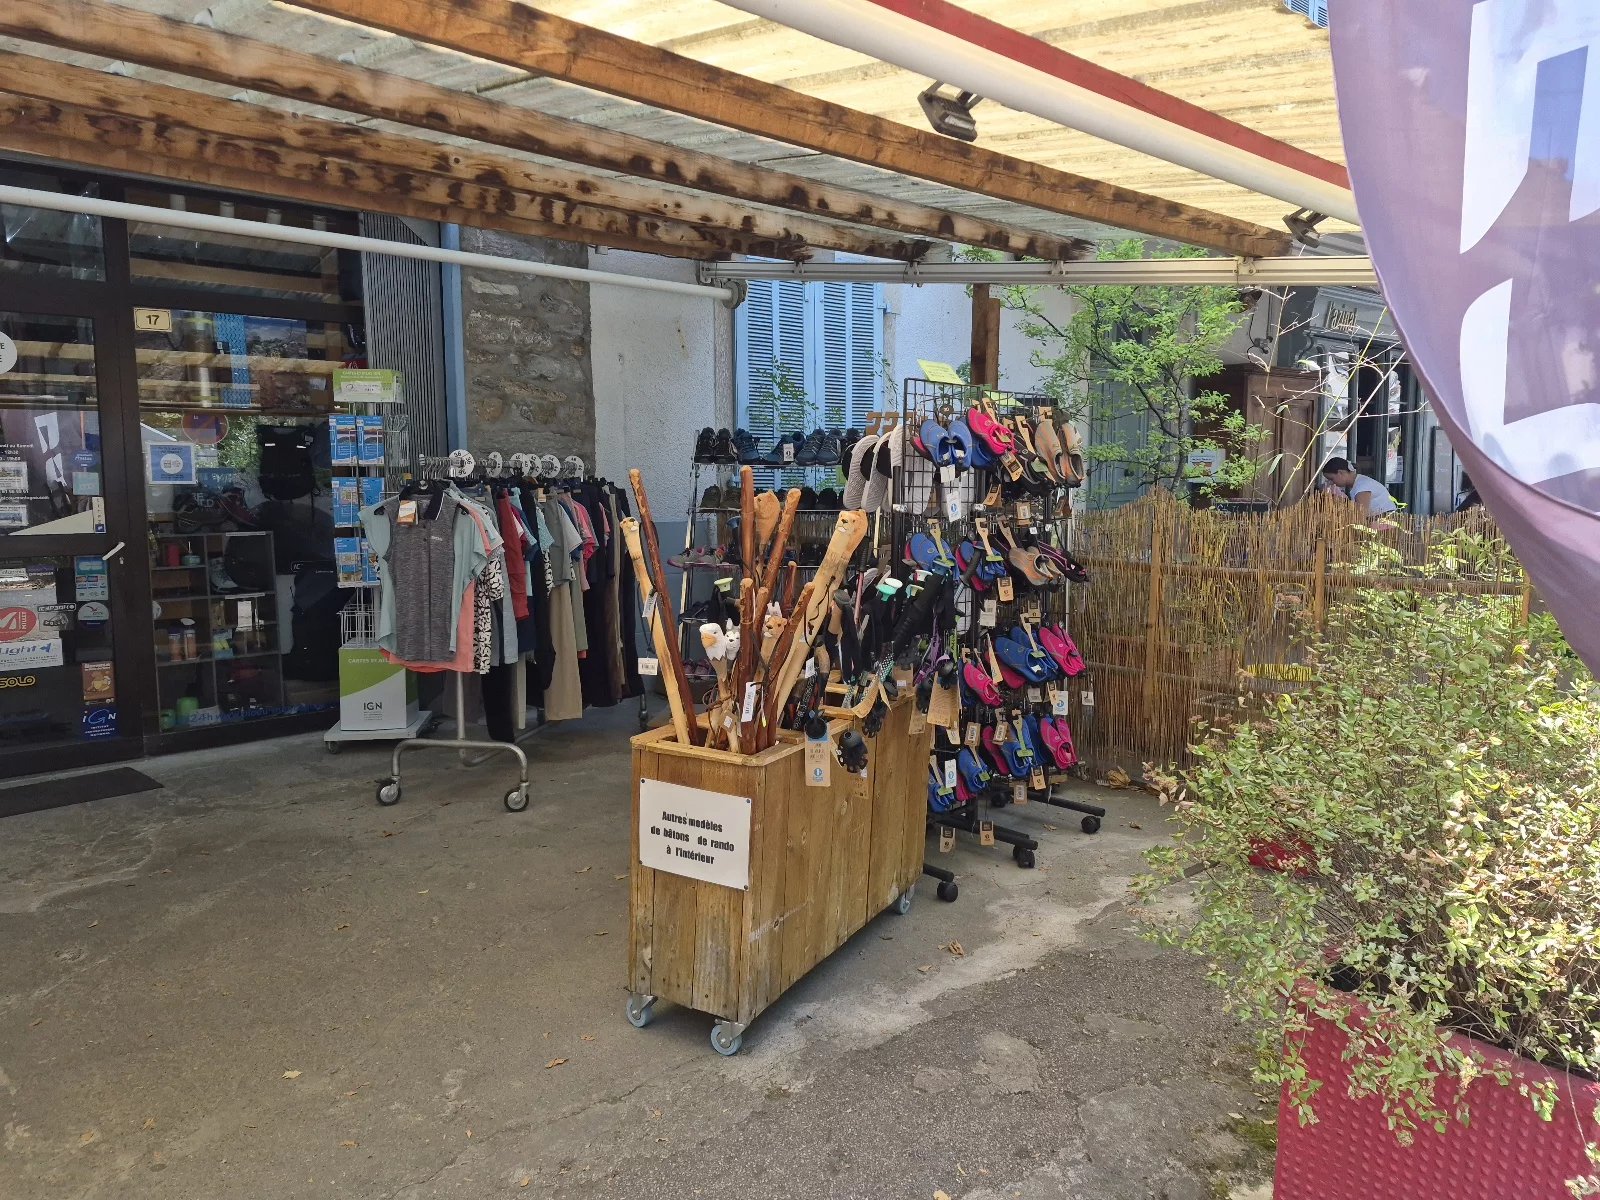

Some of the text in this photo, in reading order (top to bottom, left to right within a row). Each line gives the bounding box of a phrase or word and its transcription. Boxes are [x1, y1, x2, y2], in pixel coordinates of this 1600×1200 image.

[145, 314, 160, 326] 17
[363, 701, 383, 711] IGN
[662, 811, 723, 832] Autres modèles
[650, 825, 735, 852] de bâtons de rando
[666, 845, 715, 865] à l'intérieur
